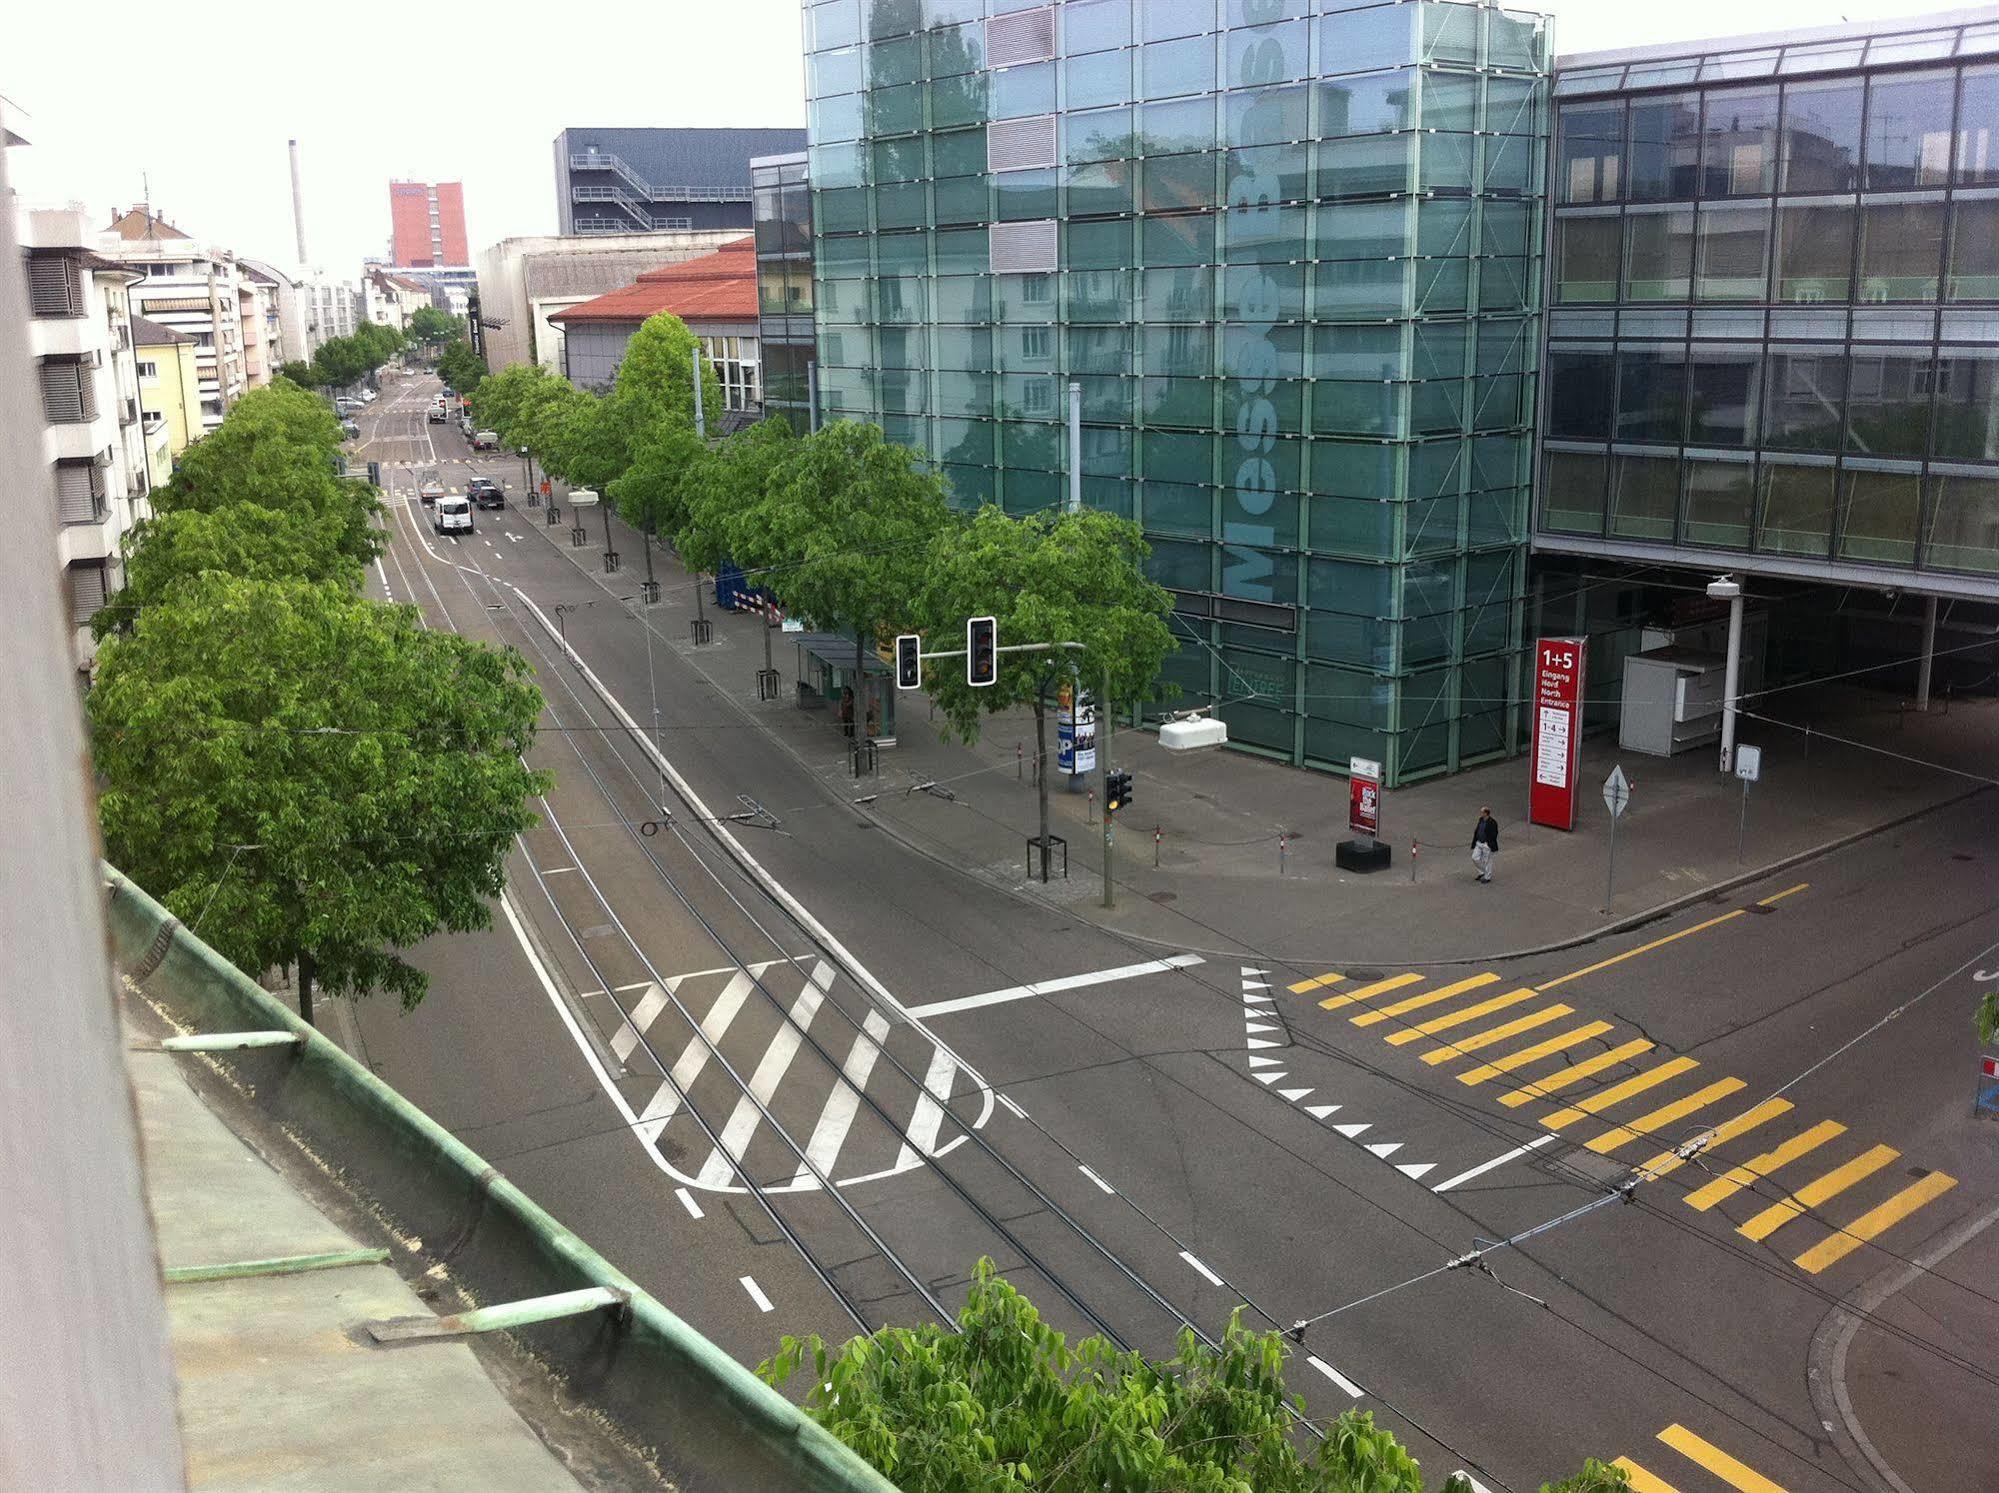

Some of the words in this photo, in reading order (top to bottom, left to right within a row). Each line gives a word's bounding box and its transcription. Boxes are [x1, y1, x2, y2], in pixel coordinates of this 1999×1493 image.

[1223, 270, 1280, 603] Messe
[1543, 649, 1573, 669] 1+5
[1541, 669, 1570, 683] Eingang
[1541, 679, 1560, 689] Nord
[1540, 688, 1561, 698] North
[1540, 697, 1571, 709] Entrance
